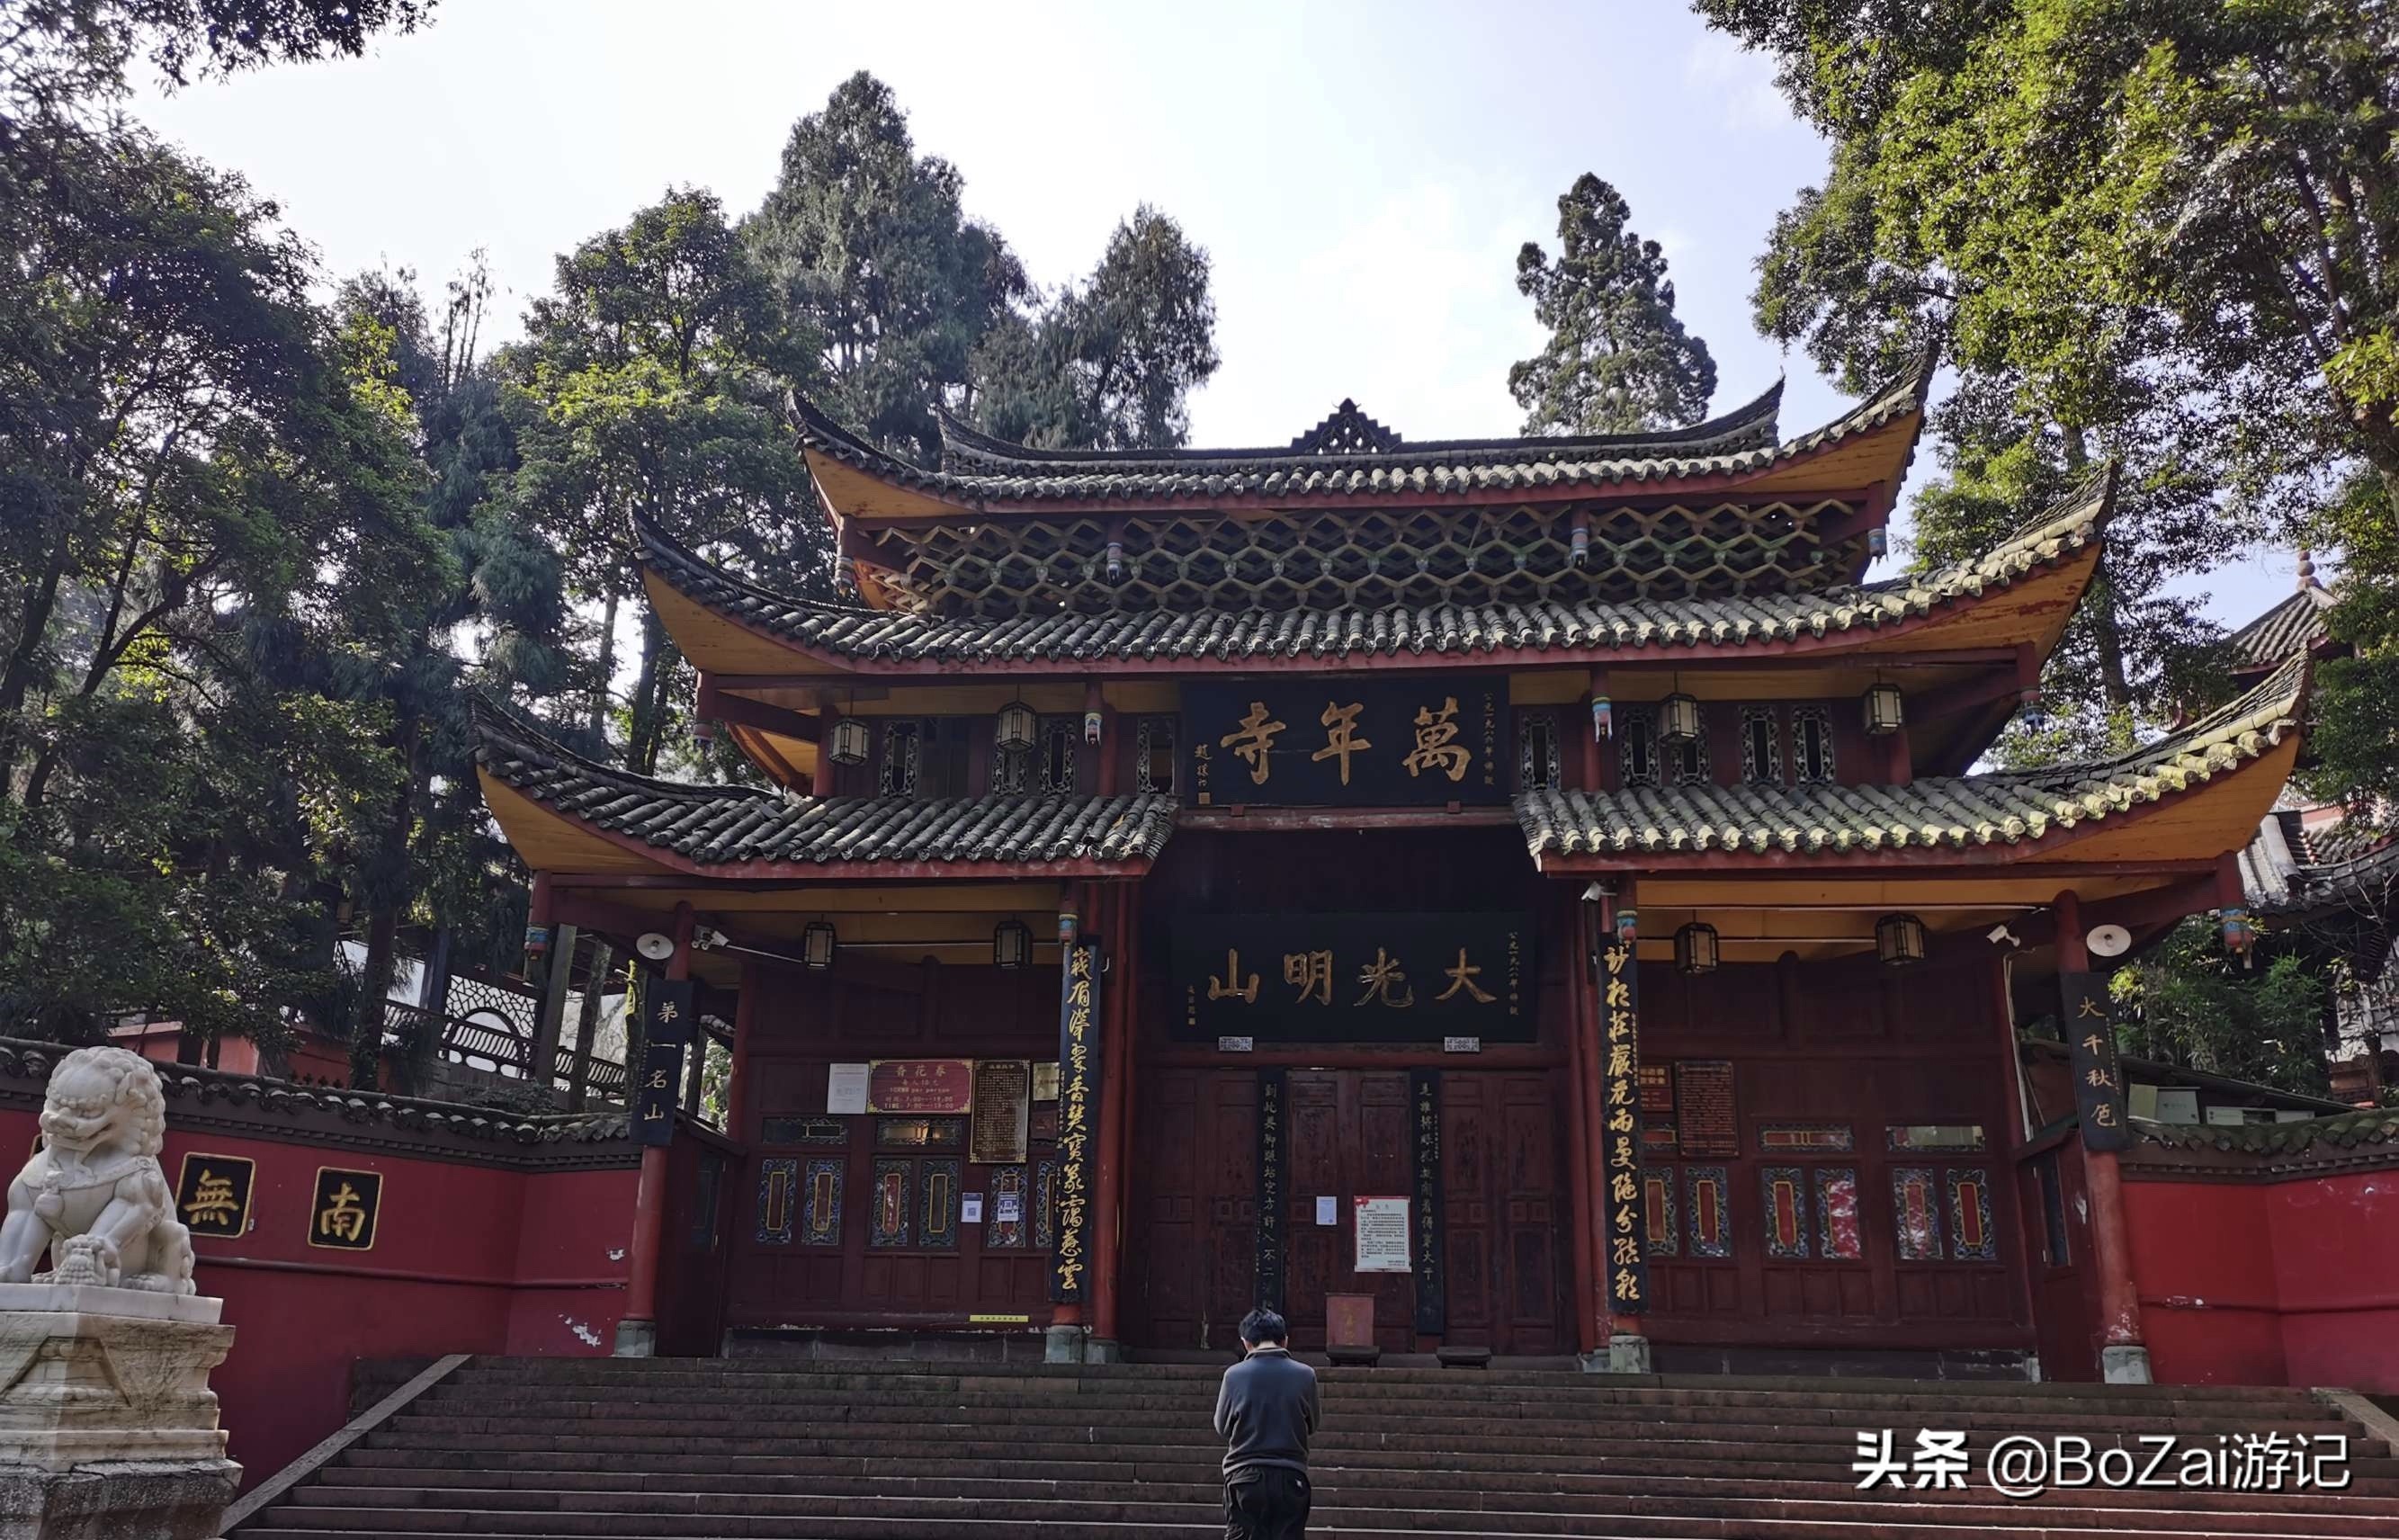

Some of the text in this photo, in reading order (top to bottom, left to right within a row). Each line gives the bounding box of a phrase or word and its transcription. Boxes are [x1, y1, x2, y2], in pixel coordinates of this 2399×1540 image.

[1221, 696, 1473, 786] 萬年寺
[1207, 947, 1497, 1007] 大光明山
[320, 1182, 365, 1242] 南
